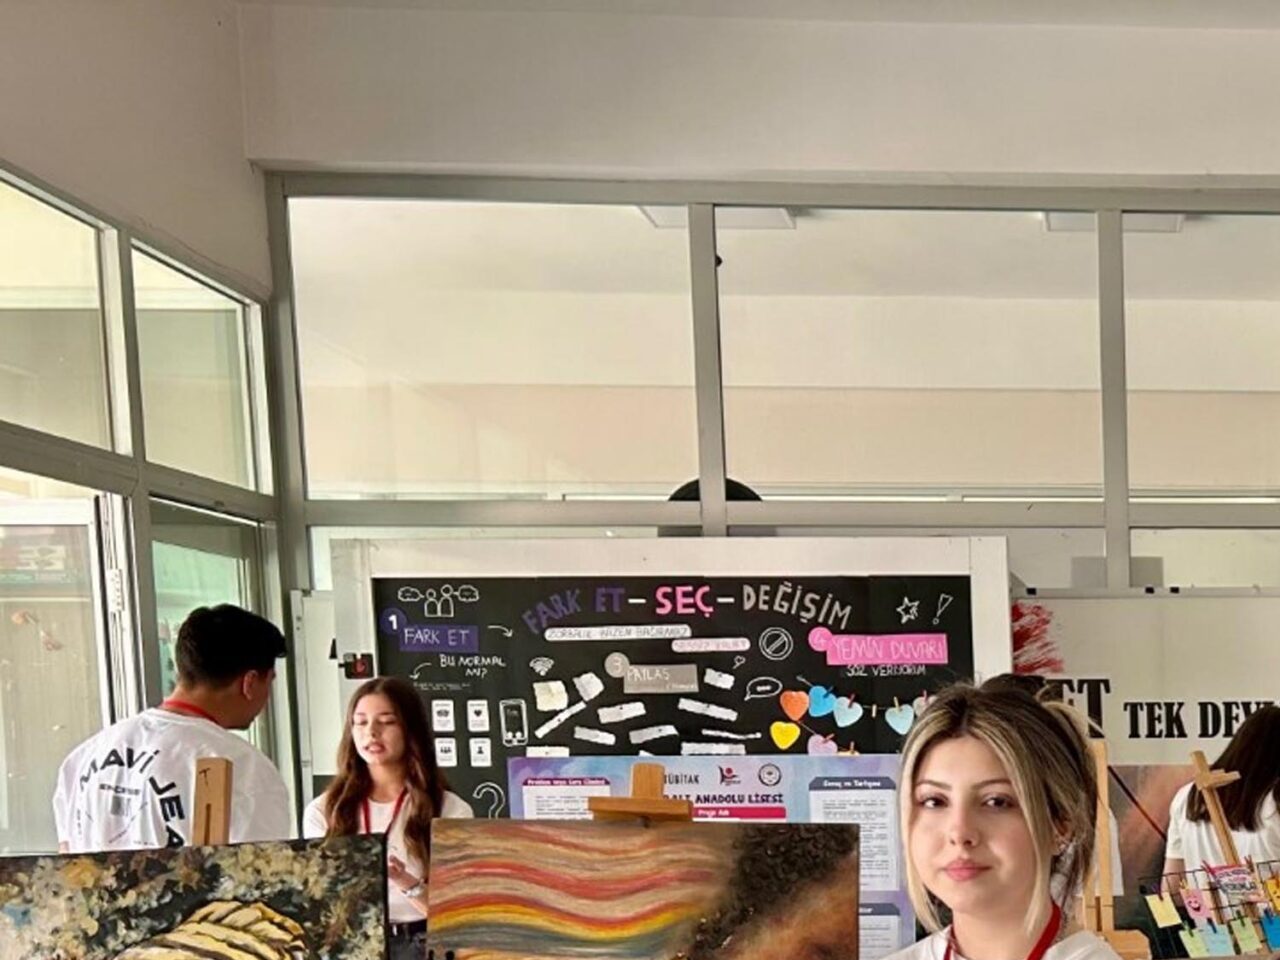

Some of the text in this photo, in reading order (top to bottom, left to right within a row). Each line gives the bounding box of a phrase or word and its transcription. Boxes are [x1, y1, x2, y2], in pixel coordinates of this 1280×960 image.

[522, 588, 581, 635] FARK
[595, 586, 625, 613] ET
[655, 585, 714, 618] SEÇ
[742, 581, 852, 630] DEĞİŞİM
[388, 614, 398, 631] 1
[404, 627, 470, 646] FARK ET
[440, 653, 506, 667] BU NORMAL
[1123, 701, 1188, 738] TEK
[695, 794, 745, 804] ANADOLU
